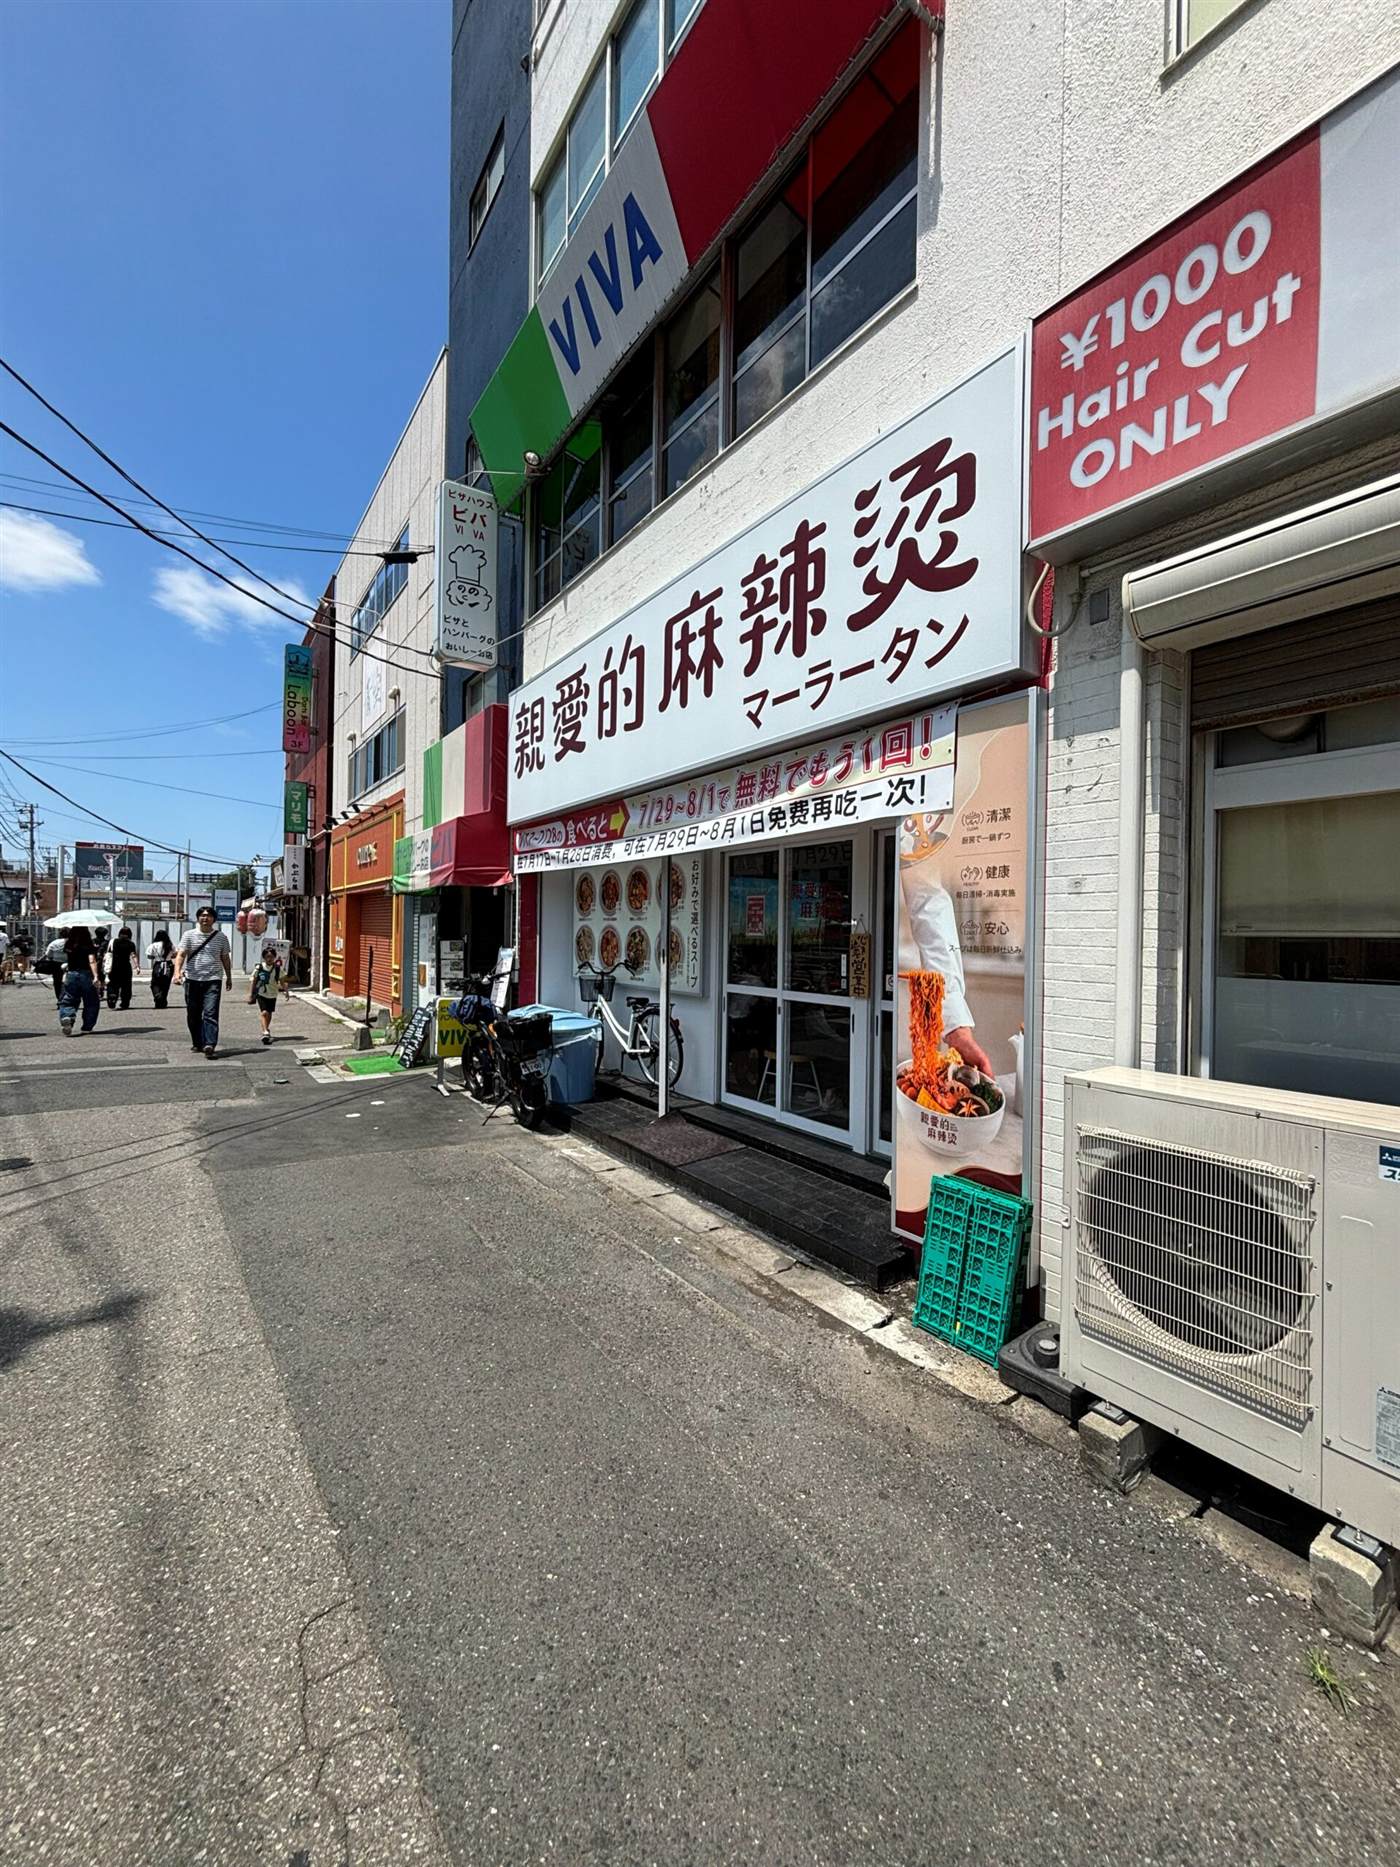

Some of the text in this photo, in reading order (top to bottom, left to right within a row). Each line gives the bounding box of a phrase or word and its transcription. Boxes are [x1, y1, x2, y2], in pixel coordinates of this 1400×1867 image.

[549, 192, 664, 376] VIVA
[1059, 209, 1272, 371] ¥1000
[1037, 271, 1301, 452] Hair Cut
[1069, 363, 1249, 489] ONLY
[743, 613, 970, 730] マーラータン
[287, 684, 301, 735] Laboon
[290, 790, 302, 823] マリモ
[986, 807, 1012, 823] 清潔
[567, 813, 608, 845] 食べると
[985, 864, 1011, 879] 健康
[984, 921, 1010, 936] 安心
[439, 1029, 467, 1046] VIV
